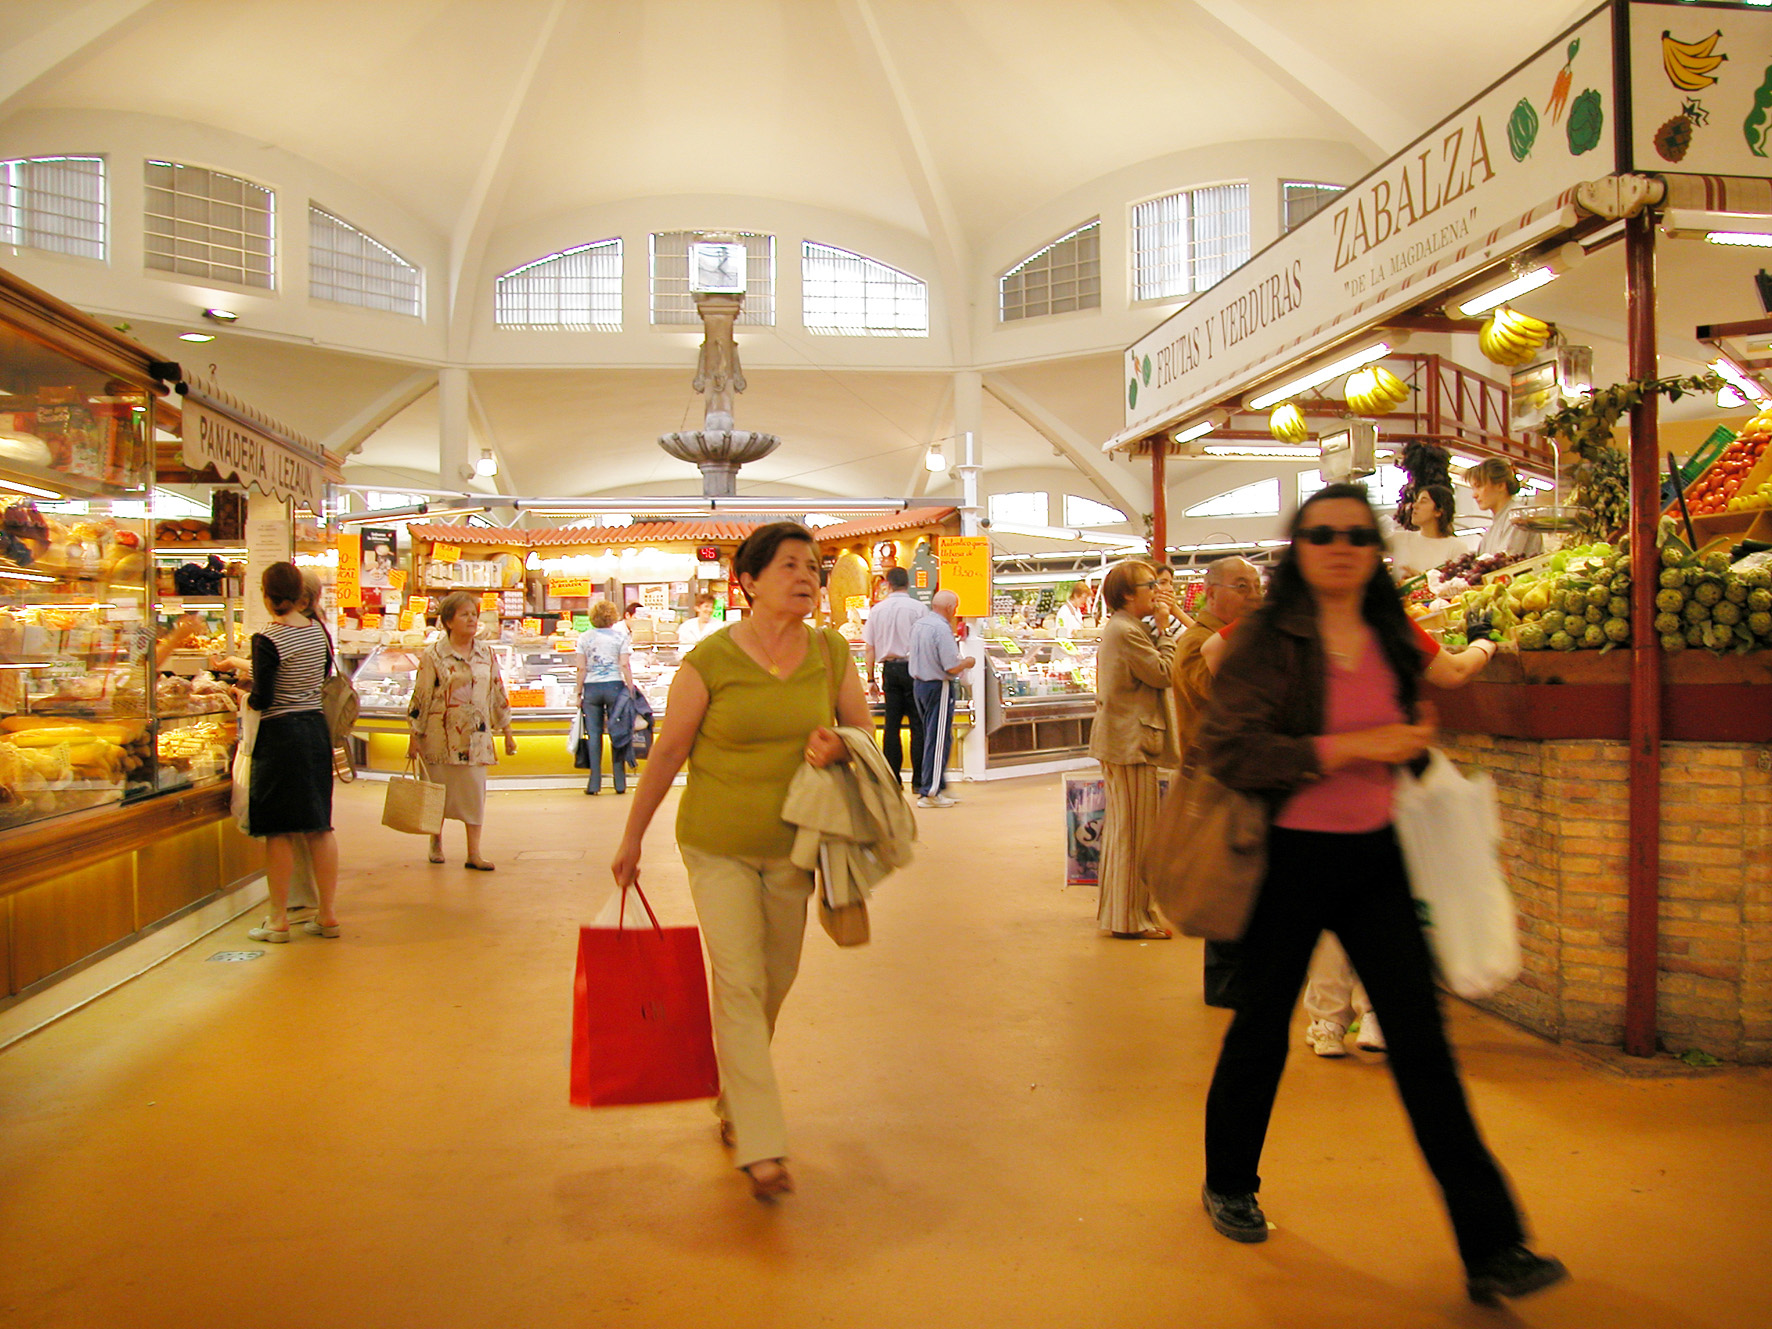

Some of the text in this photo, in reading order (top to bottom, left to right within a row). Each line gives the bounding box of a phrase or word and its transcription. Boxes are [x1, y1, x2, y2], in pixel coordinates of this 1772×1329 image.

[1333, 115, 1496, 273] ZABALZA
[1344, 206, 1477, 297] "DE LA MAGDALENA"
[1156, 259, 1302, 389] FRUTAS Y VERDURAS
[199, 415, 268, 480] PANADERIA
